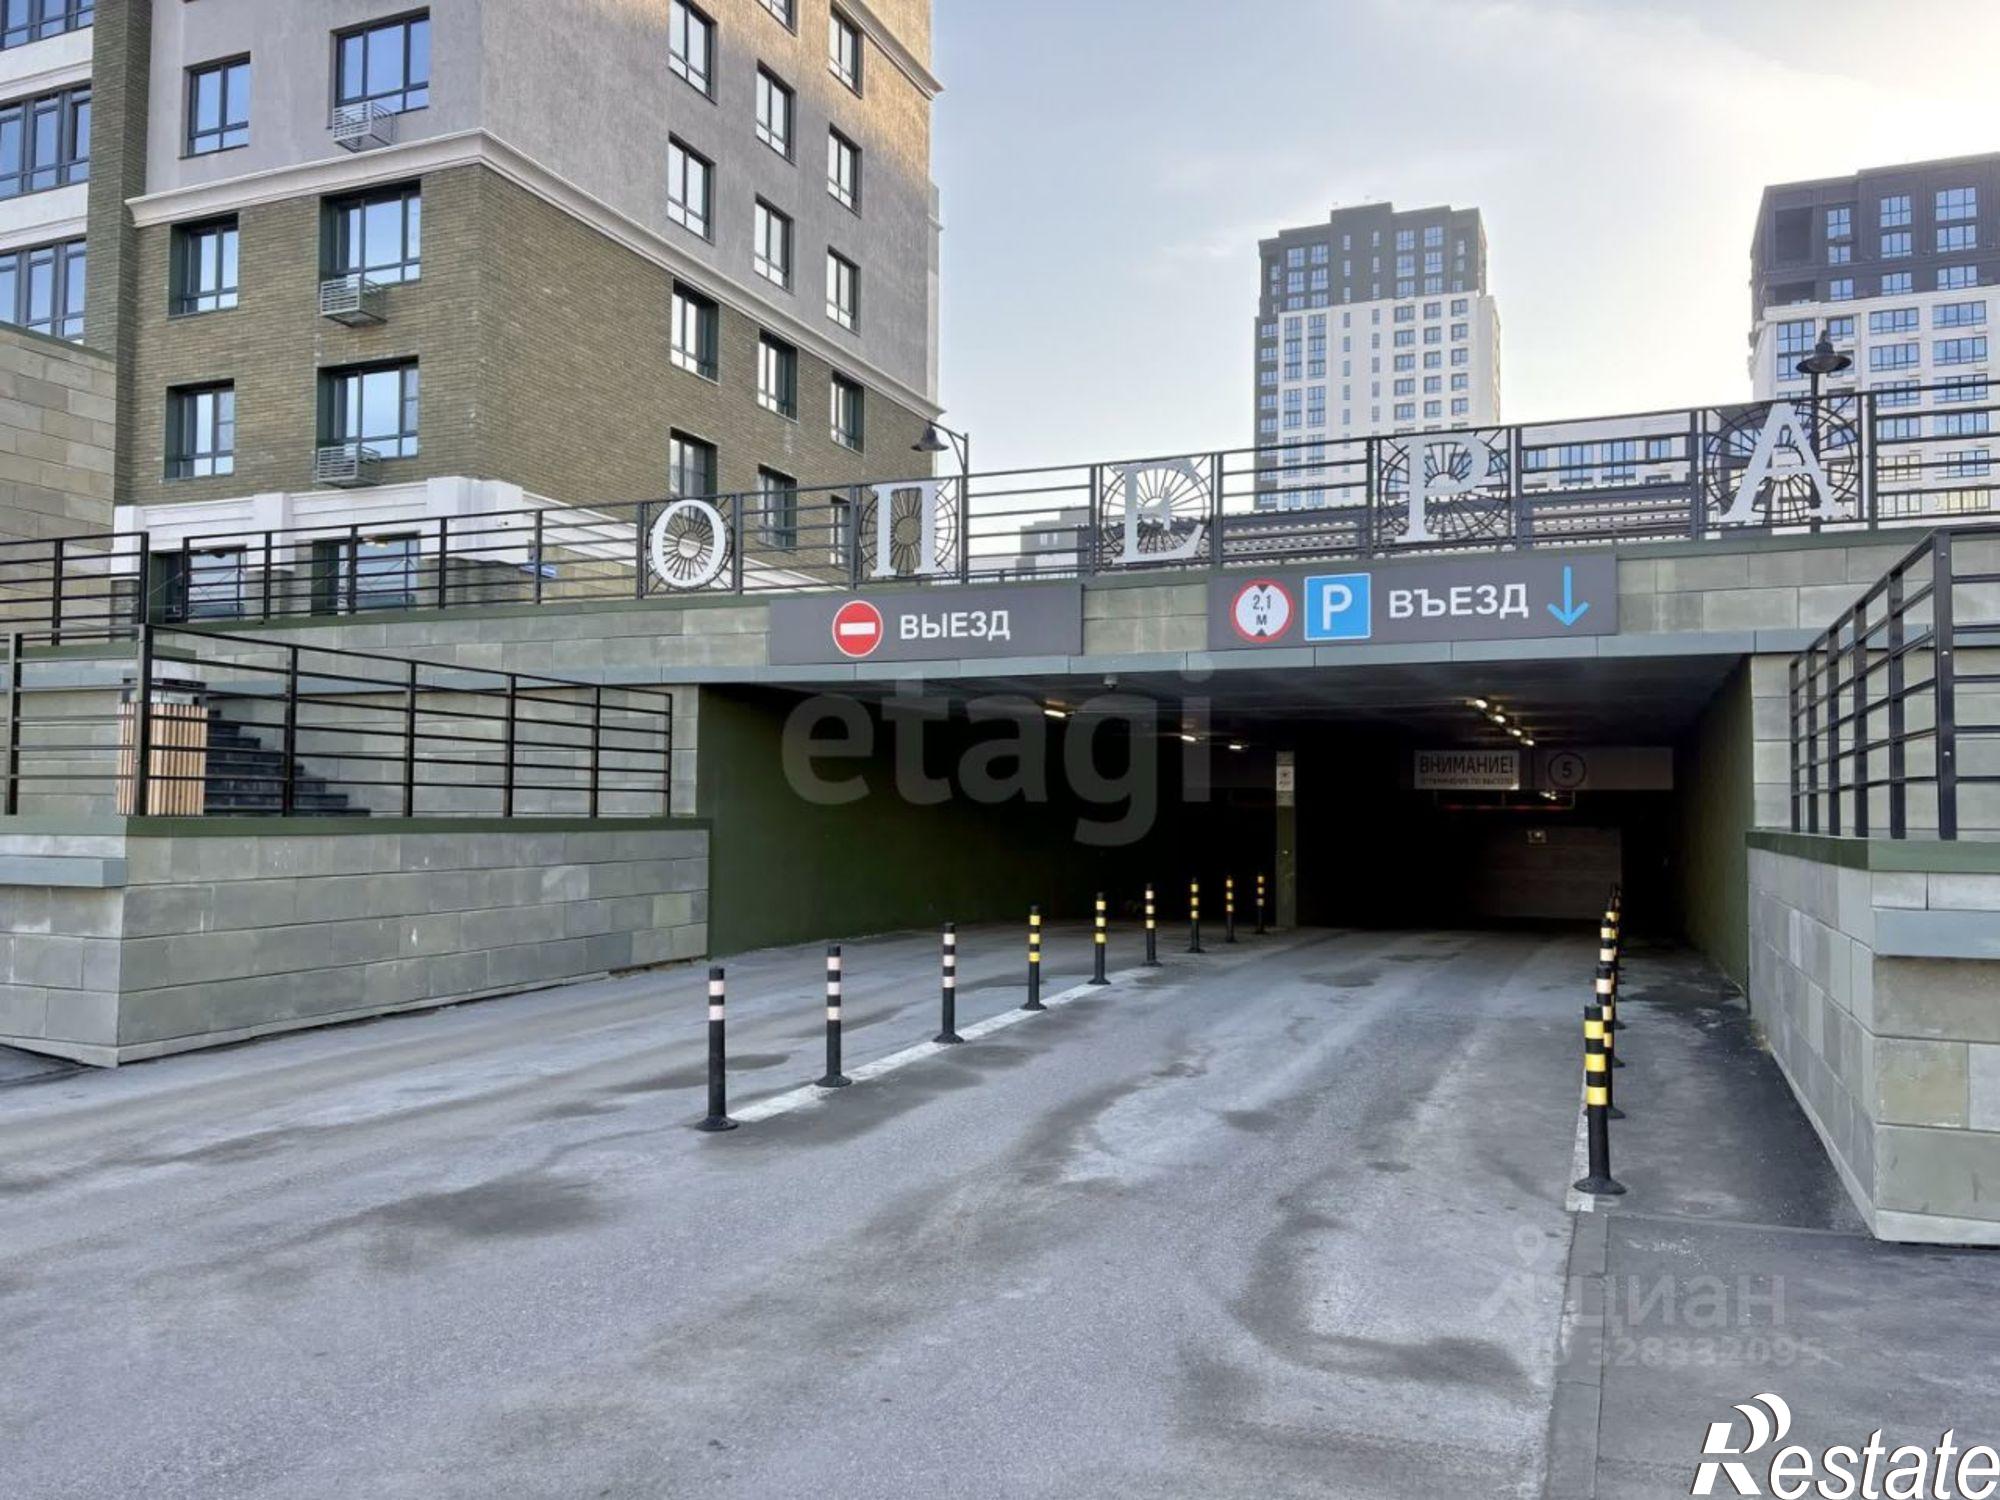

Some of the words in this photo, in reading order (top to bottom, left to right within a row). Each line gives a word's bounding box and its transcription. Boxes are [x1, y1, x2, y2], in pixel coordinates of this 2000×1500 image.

[648, 402, 1852, 588] ОПЕРА
[1252, 594, 1271, 612] 2,1
[1388, 583, 1529, 618] ВЪЕЗД
[900, 610, 1010, 641] ВЫЕЗД
[1419, 755, 1513, 774] ВНИМАНИЕ!
[1562, 761, 1572, 779] 5
